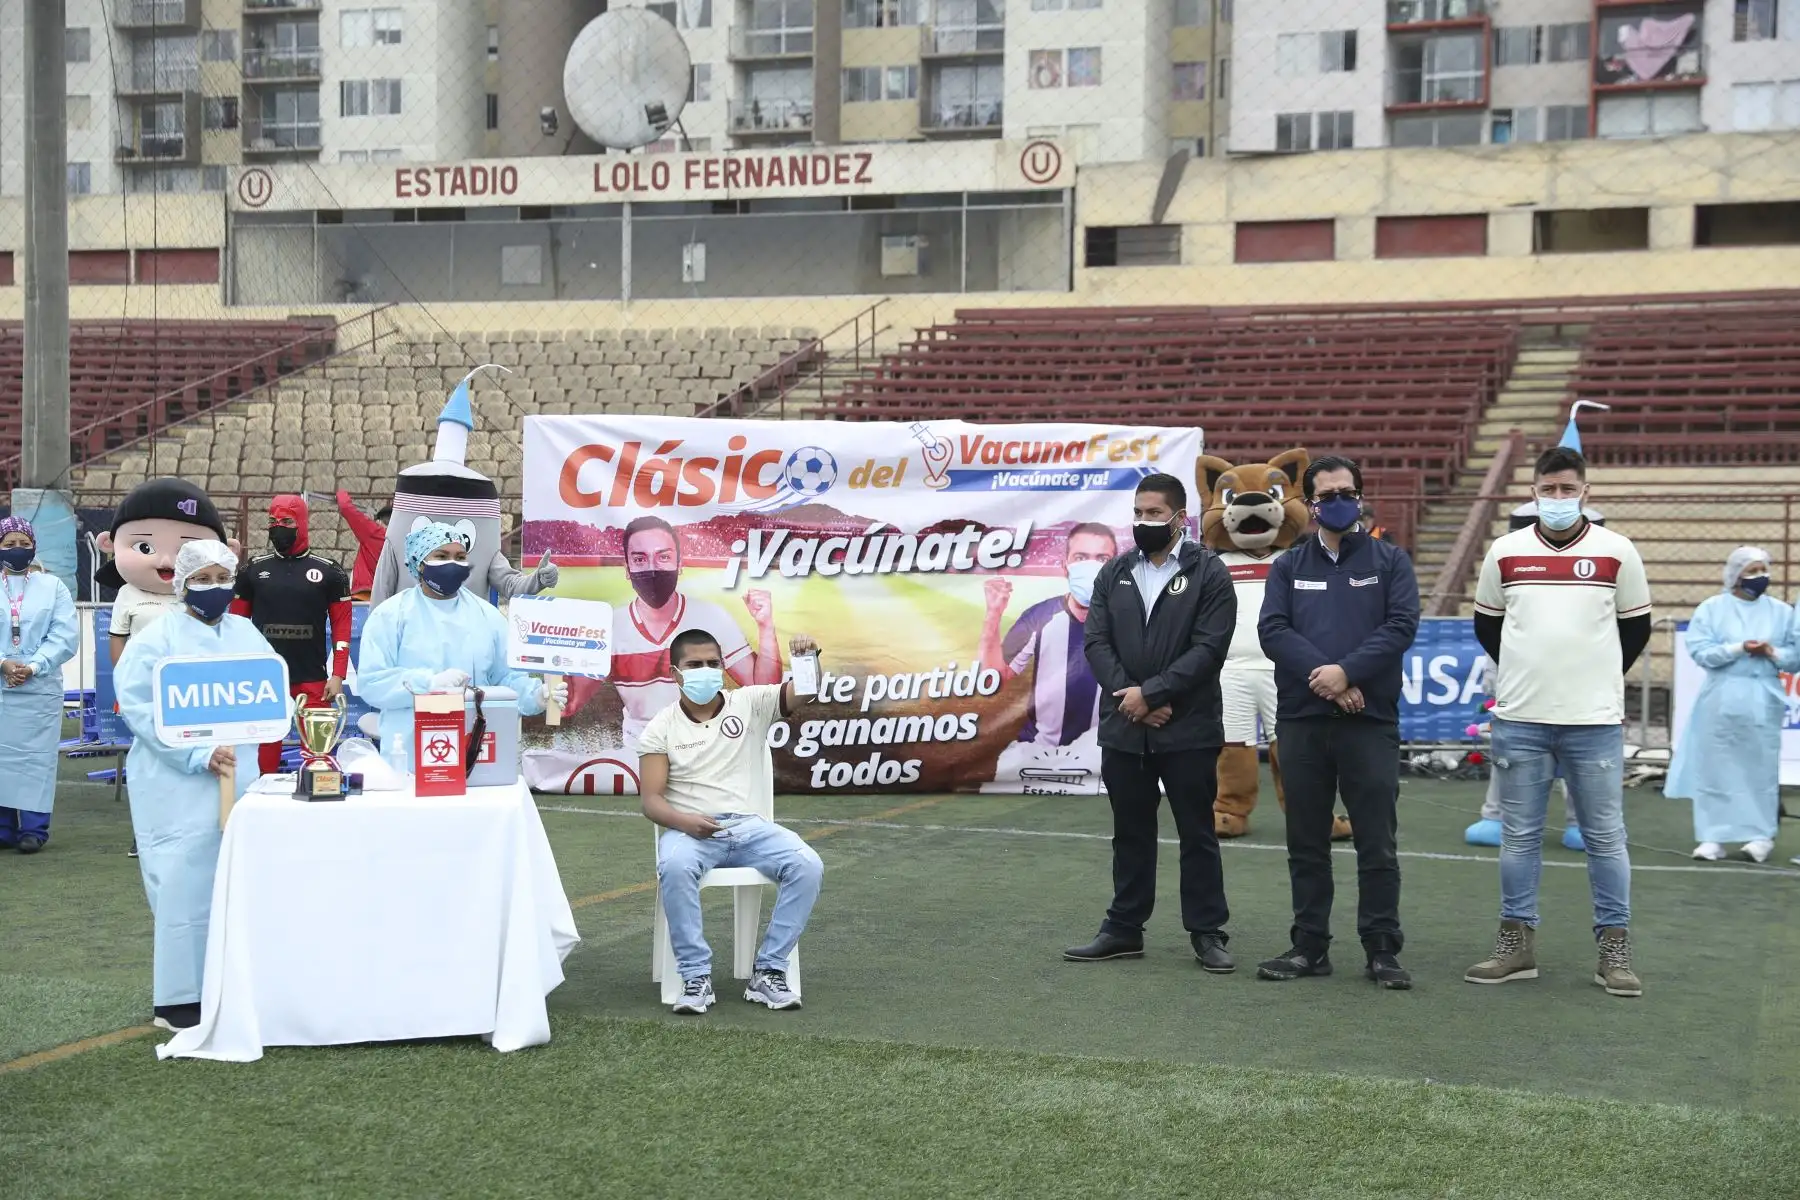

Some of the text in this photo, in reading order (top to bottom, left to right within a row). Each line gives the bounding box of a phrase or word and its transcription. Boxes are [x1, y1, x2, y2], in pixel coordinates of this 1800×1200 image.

[395, 152, 873, 198] ESTADIO LOLO FERNANDEZ
[959, 432, 1163, 465] VacunaFest
[848, 457, 908, 489] del
[1080, 471, 1110, 490] ya!
[721, 518, 1035, 589] ¡Vacúnate!
[531, 621, 607, 639] VacunaFest
[167, 679, 279, 709] MINSA
[860, 660, 1001, 713] partido
[1401, 654, 1488, 706] NSA
[794, 712, 979, 758] ganamos
[810, 752, 923, 789] todos
[1023, 785, 1075, 796] Estadi
